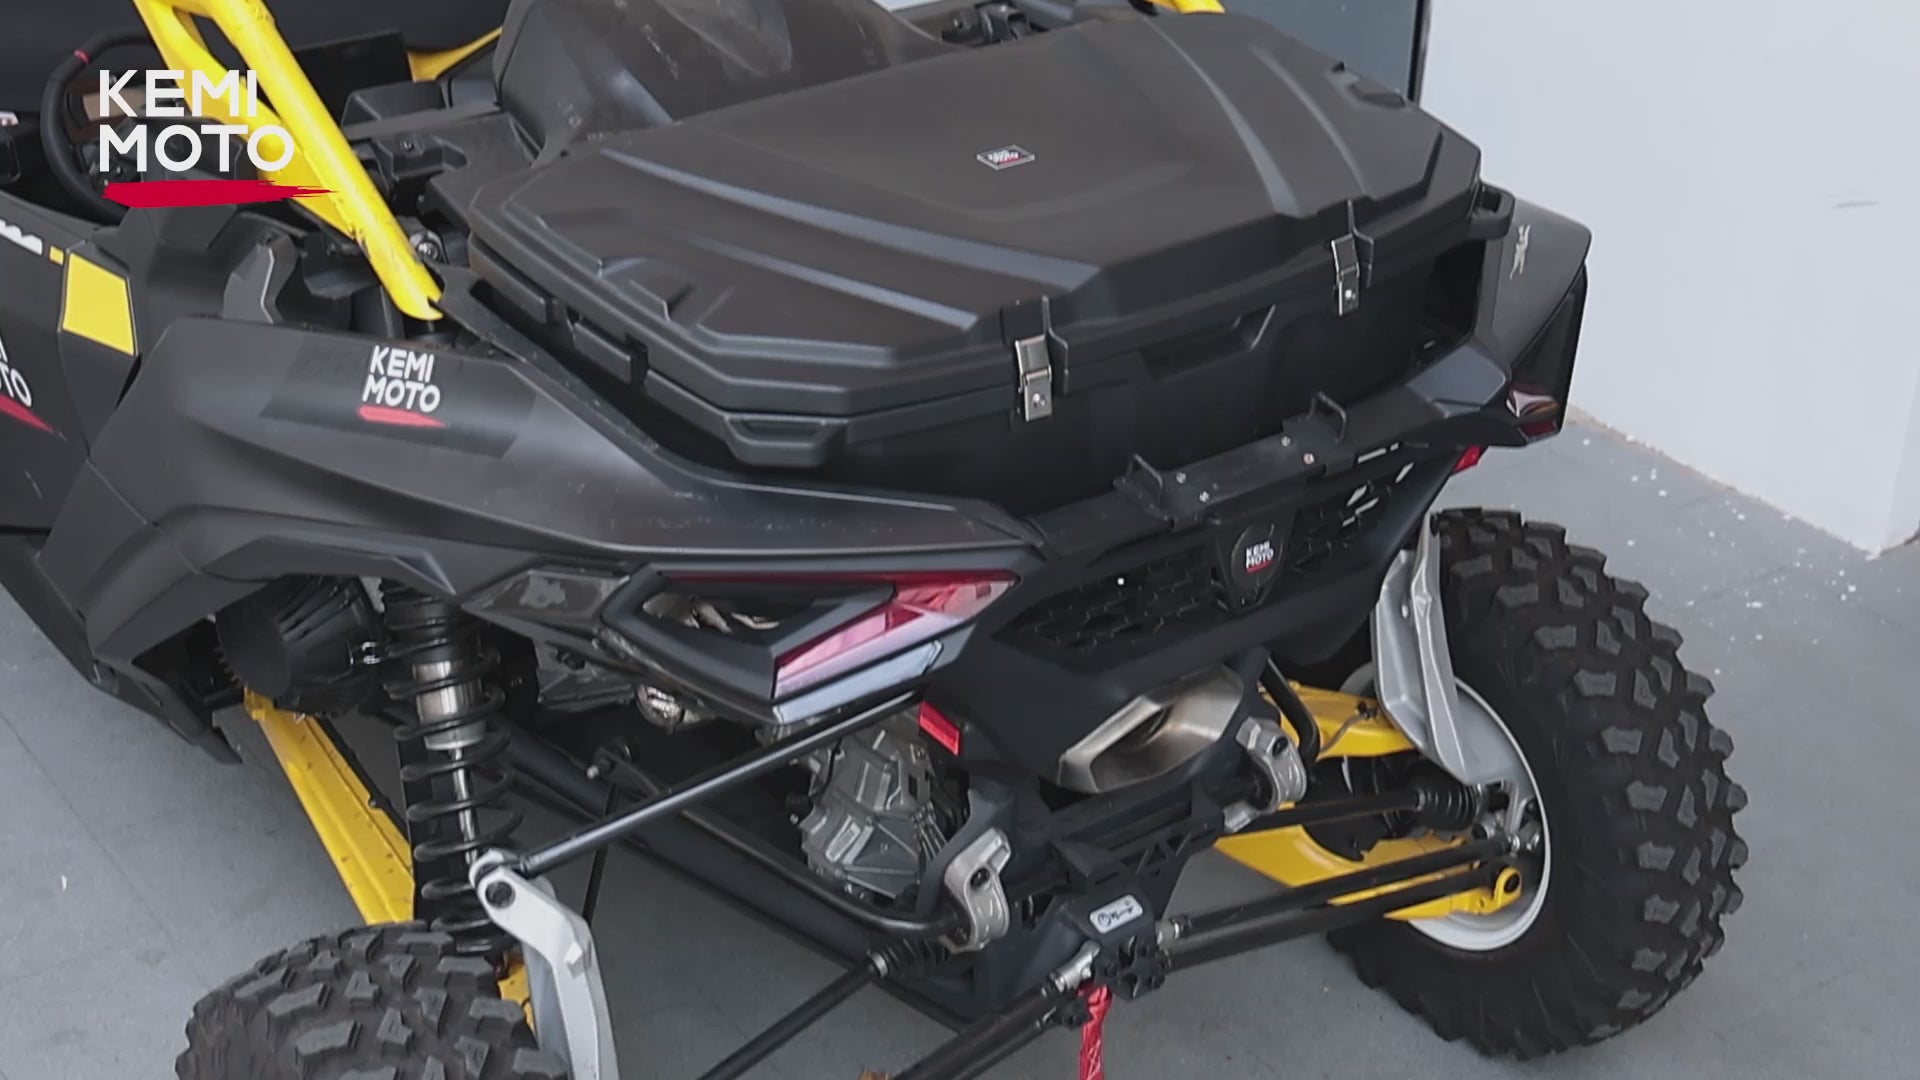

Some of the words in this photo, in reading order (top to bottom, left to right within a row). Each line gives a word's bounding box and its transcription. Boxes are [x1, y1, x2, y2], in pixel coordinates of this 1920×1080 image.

[370, 345, 434, 383] KEMI
[362, 374, 440, 413] MOTO
[1246, 548, 1274, 569] MOTO
